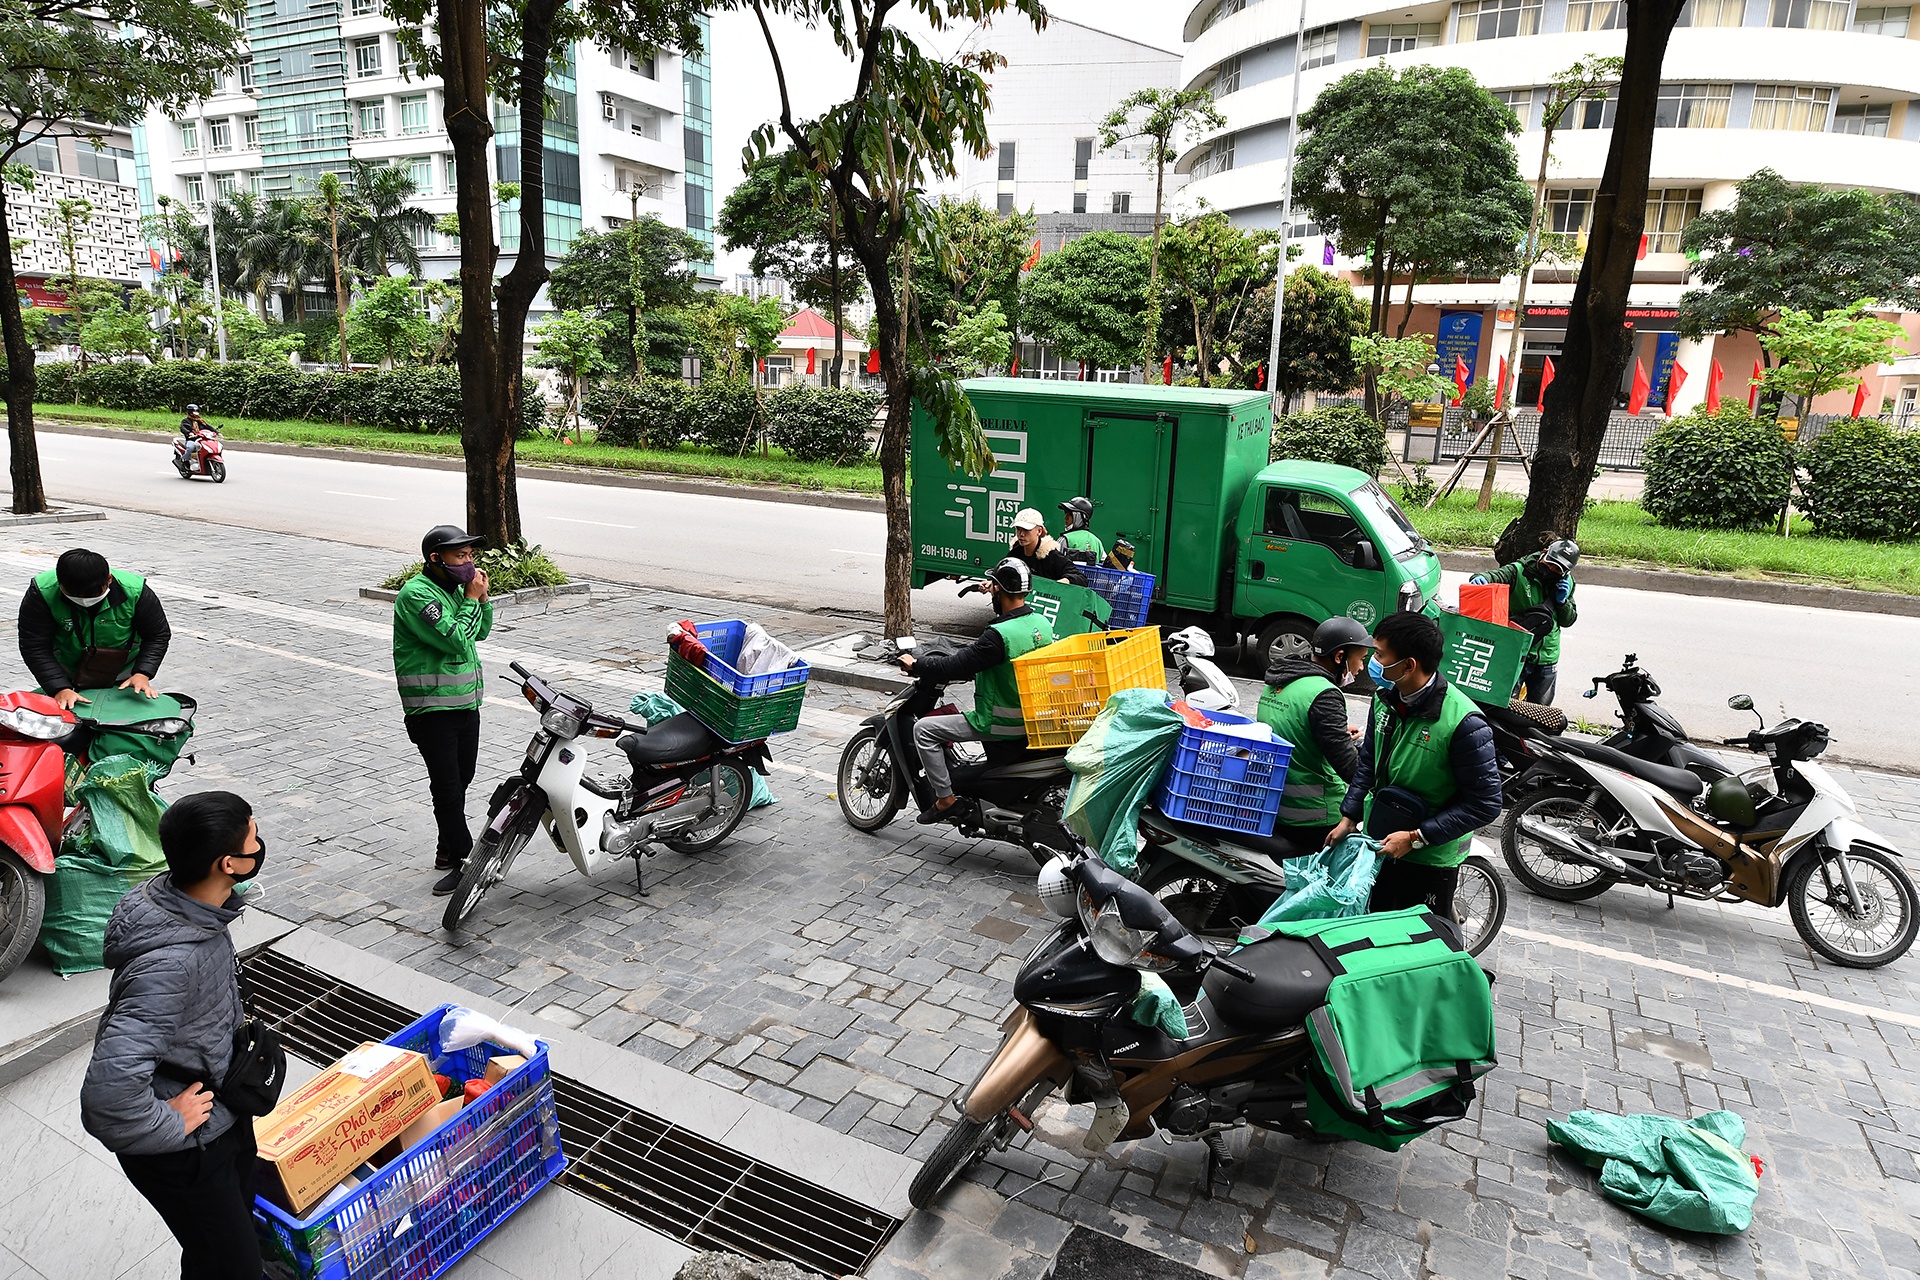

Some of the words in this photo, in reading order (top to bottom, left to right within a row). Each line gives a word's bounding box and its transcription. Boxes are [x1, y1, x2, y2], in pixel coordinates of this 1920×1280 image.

[1527, 307, 1546, 315] CHÀO
[1651, 309, 1668, 318] TRÀO
[981, 418, 1028, 431] BELIEVE
[1237, 423, 1244, 440] XE
[921, 544, 968, 560] 29H-159.68
[1113, 1041, 1140, 1055] HONDA
[335, 1109, 368, 1138] Phở
[339, 1128, 377, 1153] Trộn
